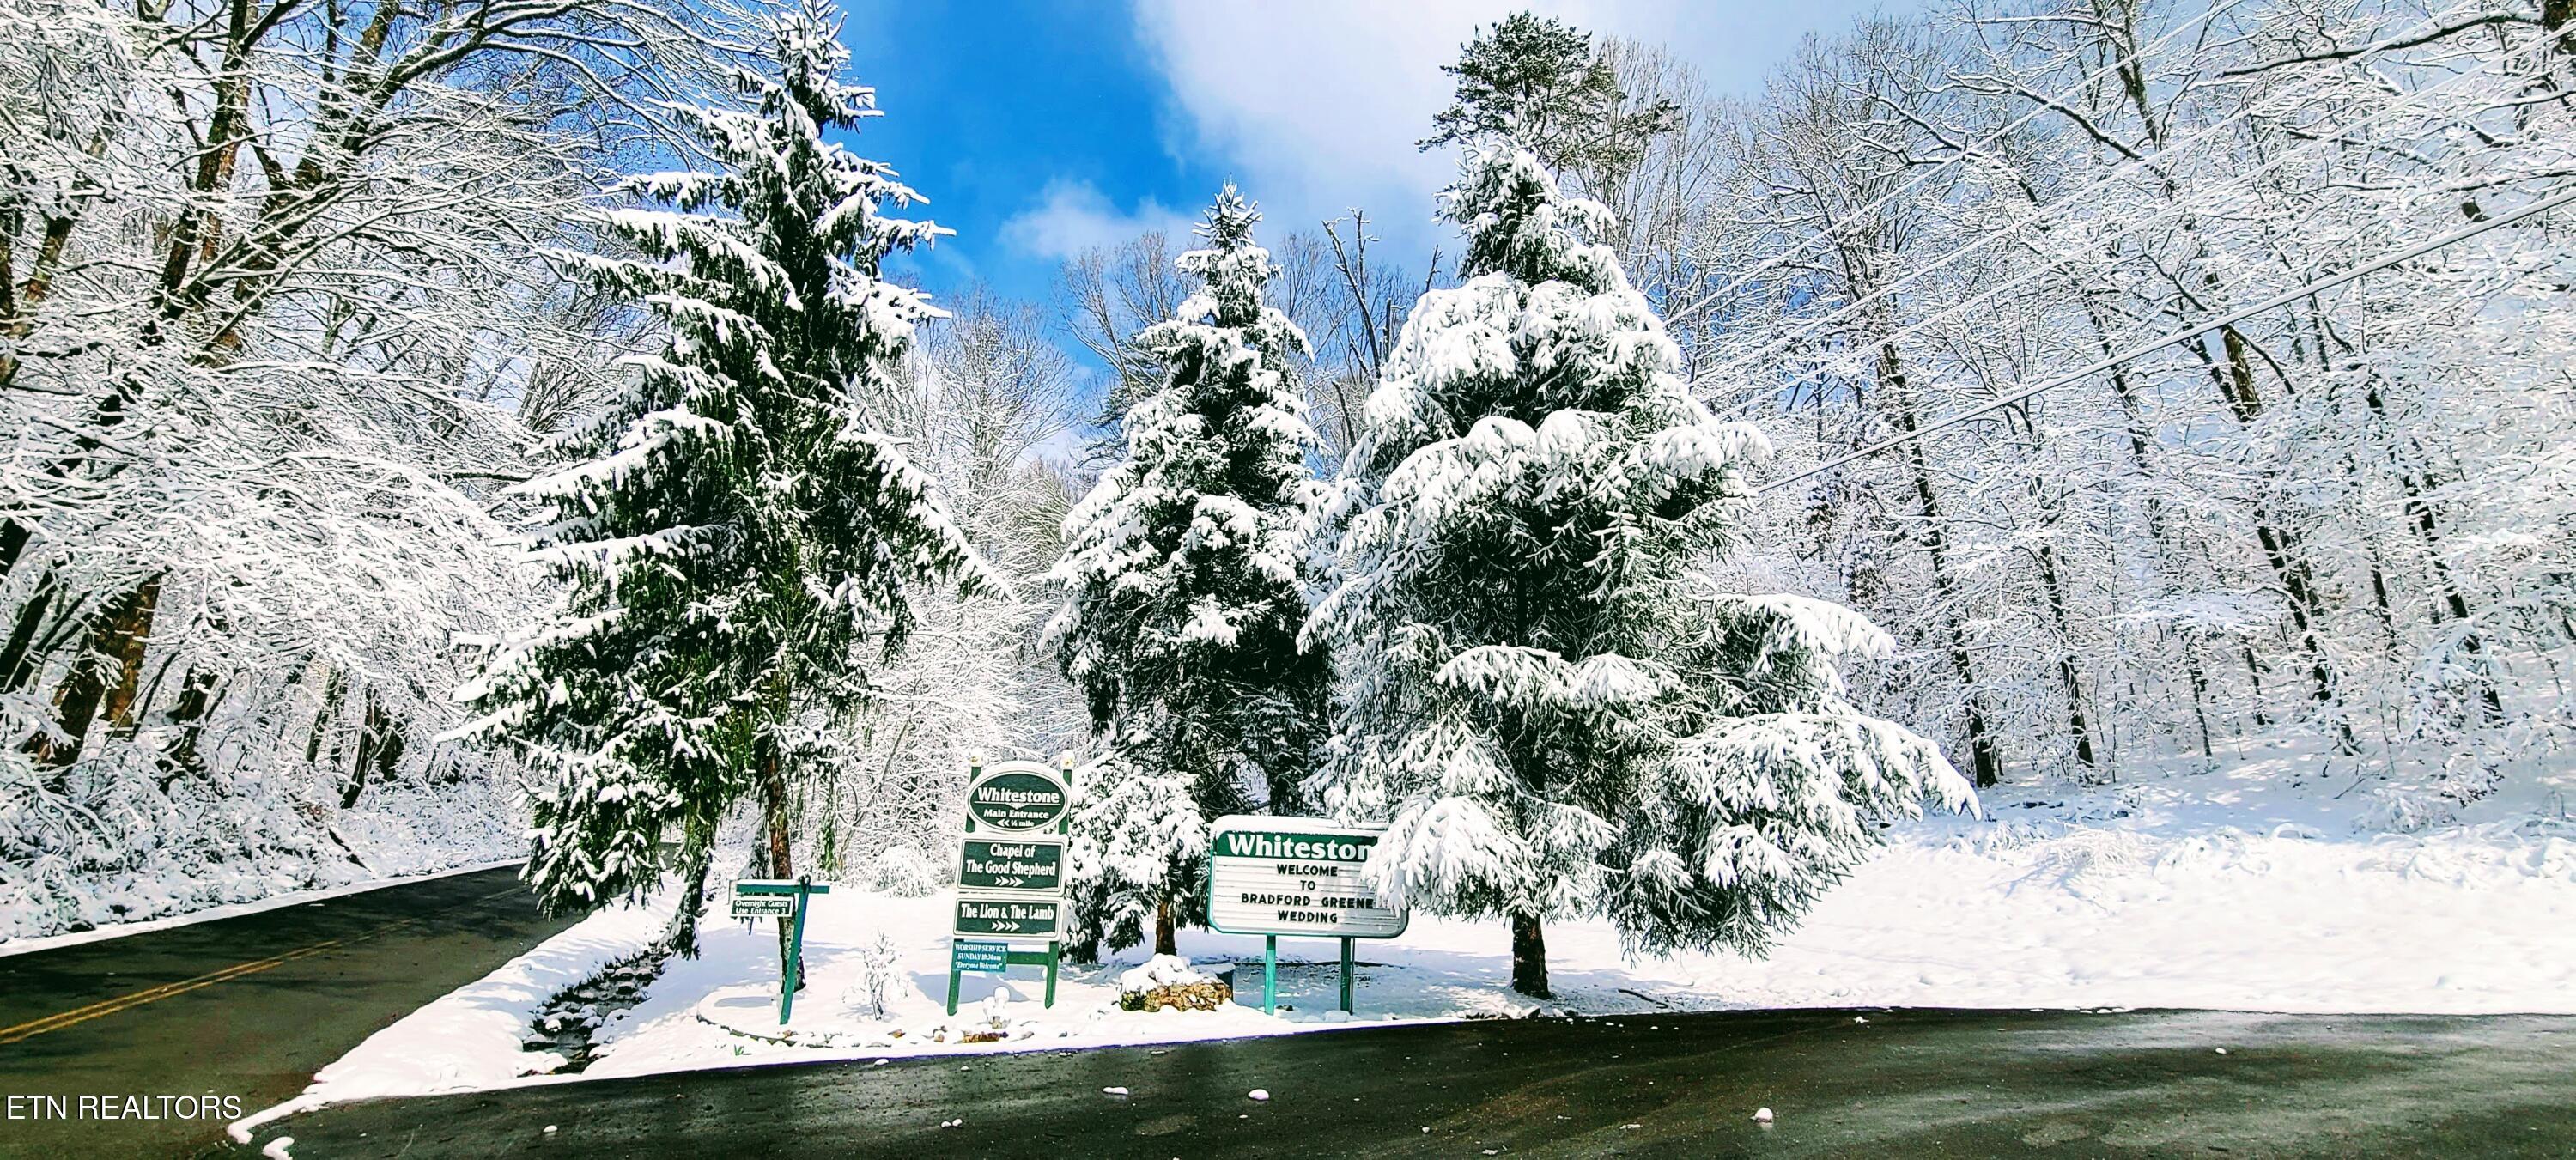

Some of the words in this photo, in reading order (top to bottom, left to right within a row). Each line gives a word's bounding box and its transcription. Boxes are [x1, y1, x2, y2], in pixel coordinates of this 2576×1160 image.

[977, 787, 1060, 804] Whitestone
[984, 809, 1006, 817] Main
[1009, 810, 1049, 819] Entrance
[990, 843, 1023, 859] Chapel
[1024, 845, 1036, 857] of
[1227, 833, 1375, 860] Whiteston
[967, 860, 983, 873] The
[986, 860, 1010, 874] Good
[1012, 861, 1055, 878] Shepherd
[1277, 864, 1338, 877] WELCOME
[1300, 880, 1315, 890] TO
[1241, 893, 1310, 905] BRADFORD
[1321, 897, 1373, 908] GREENE
[962, 903, 977, 918] The
[980, 904, 999, 919] Lion
[1001, 906, 1007, 919] &
[1010, 905, 1027, 919] The
[1029, 905, 1054, 920] Lamb
[1278, 910, 1337, 924] WEDDING
